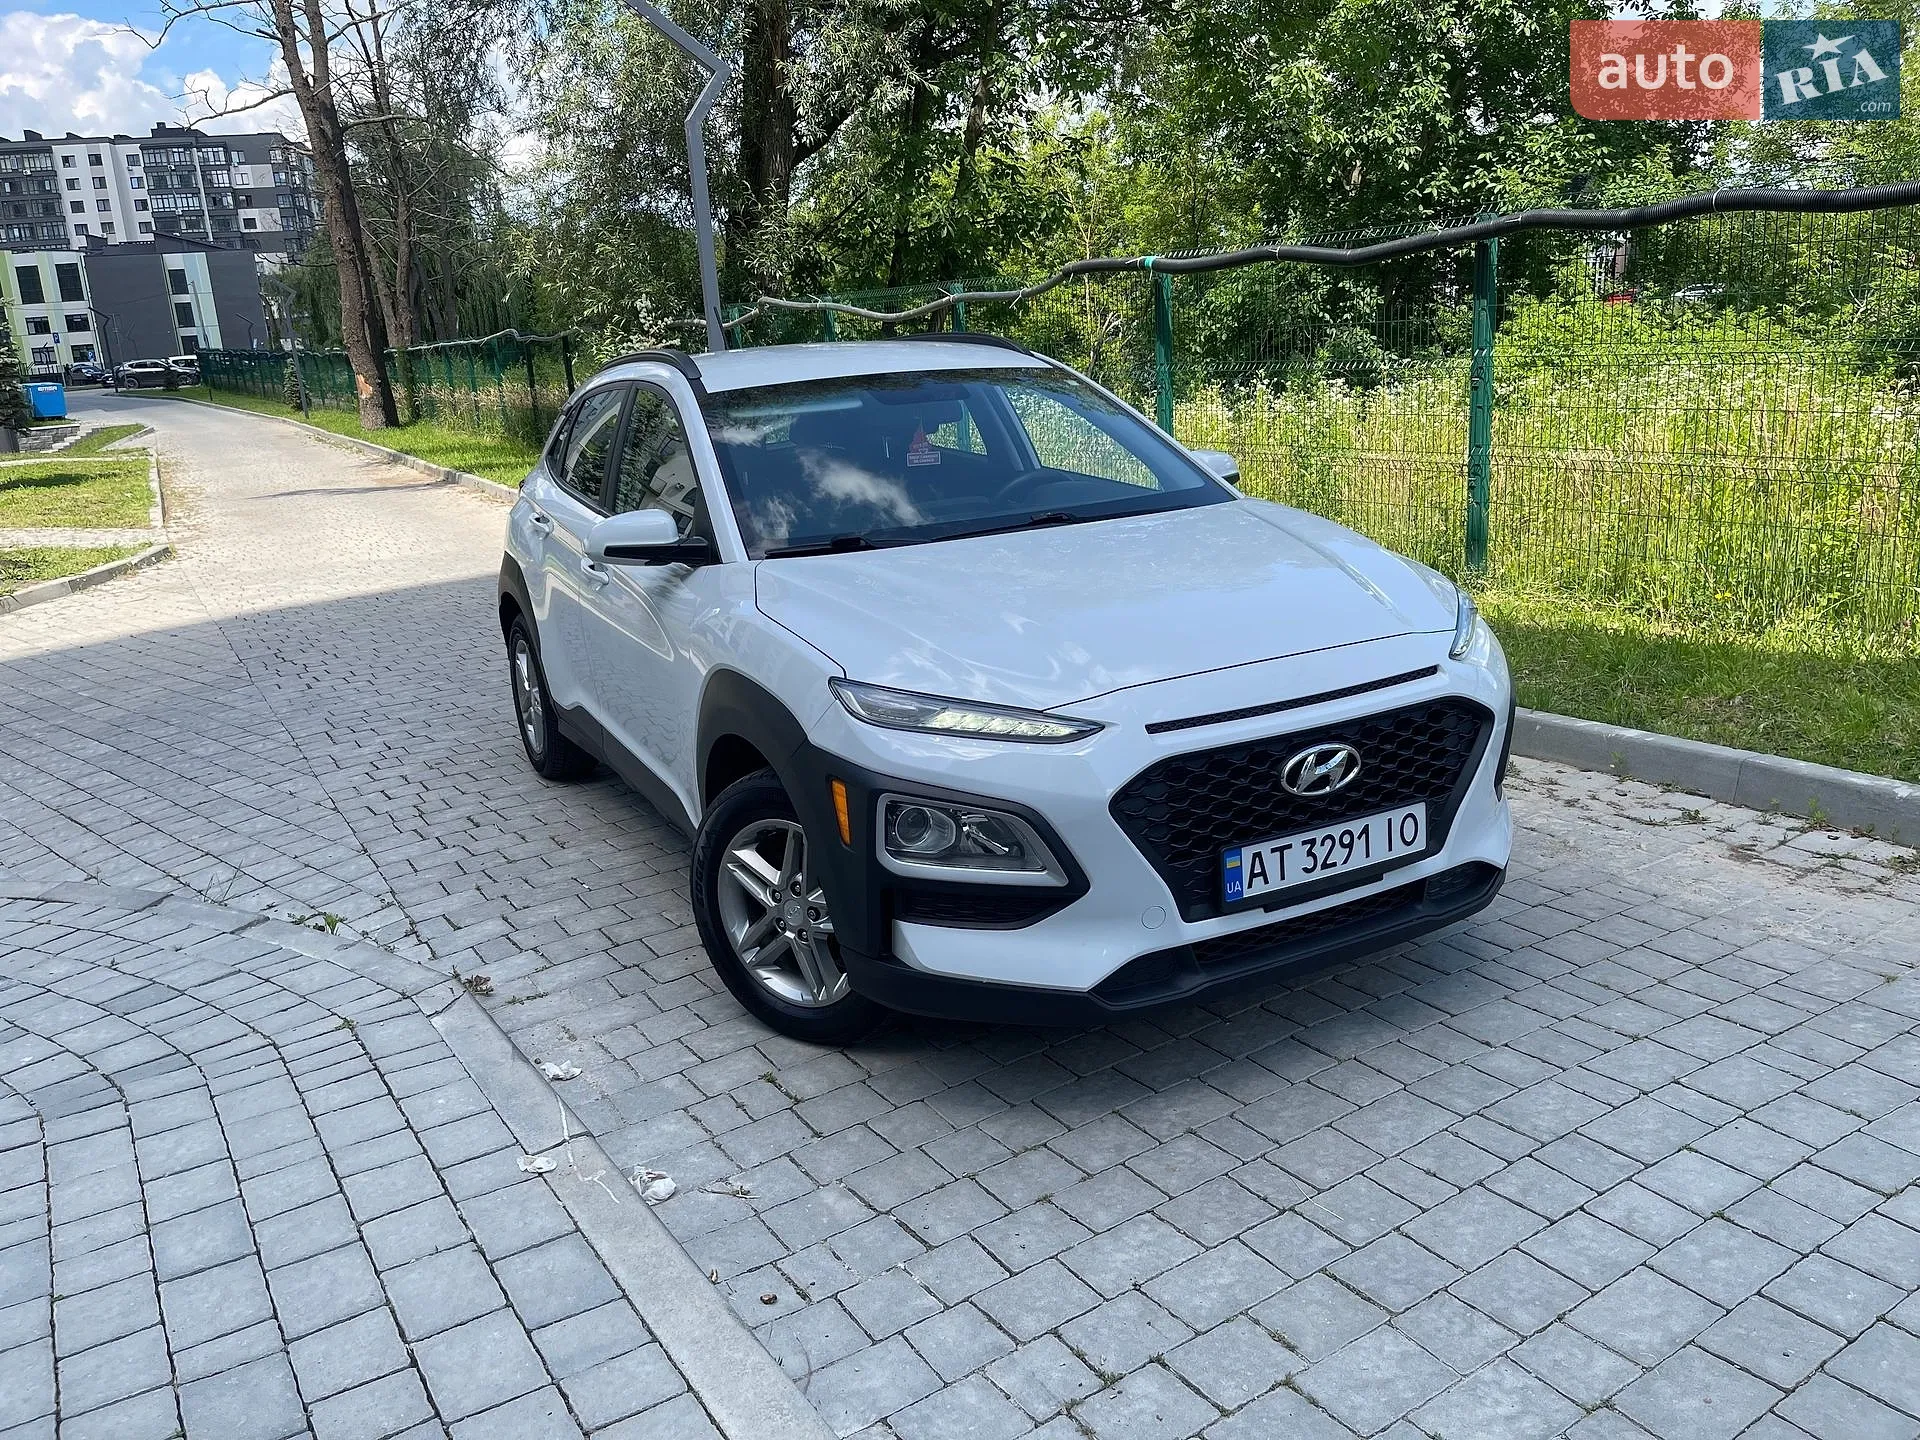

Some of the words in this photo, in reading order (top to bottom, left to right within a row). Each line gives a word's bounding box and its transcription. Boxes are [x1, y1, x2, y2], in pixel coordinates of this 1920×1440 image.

[1247, 843, 1293, 890] AT
[1301, 823, 1370, 875] 3291
[1387, 812, 1419, 853] IO
[1226, 880, 1242, 894] UA
